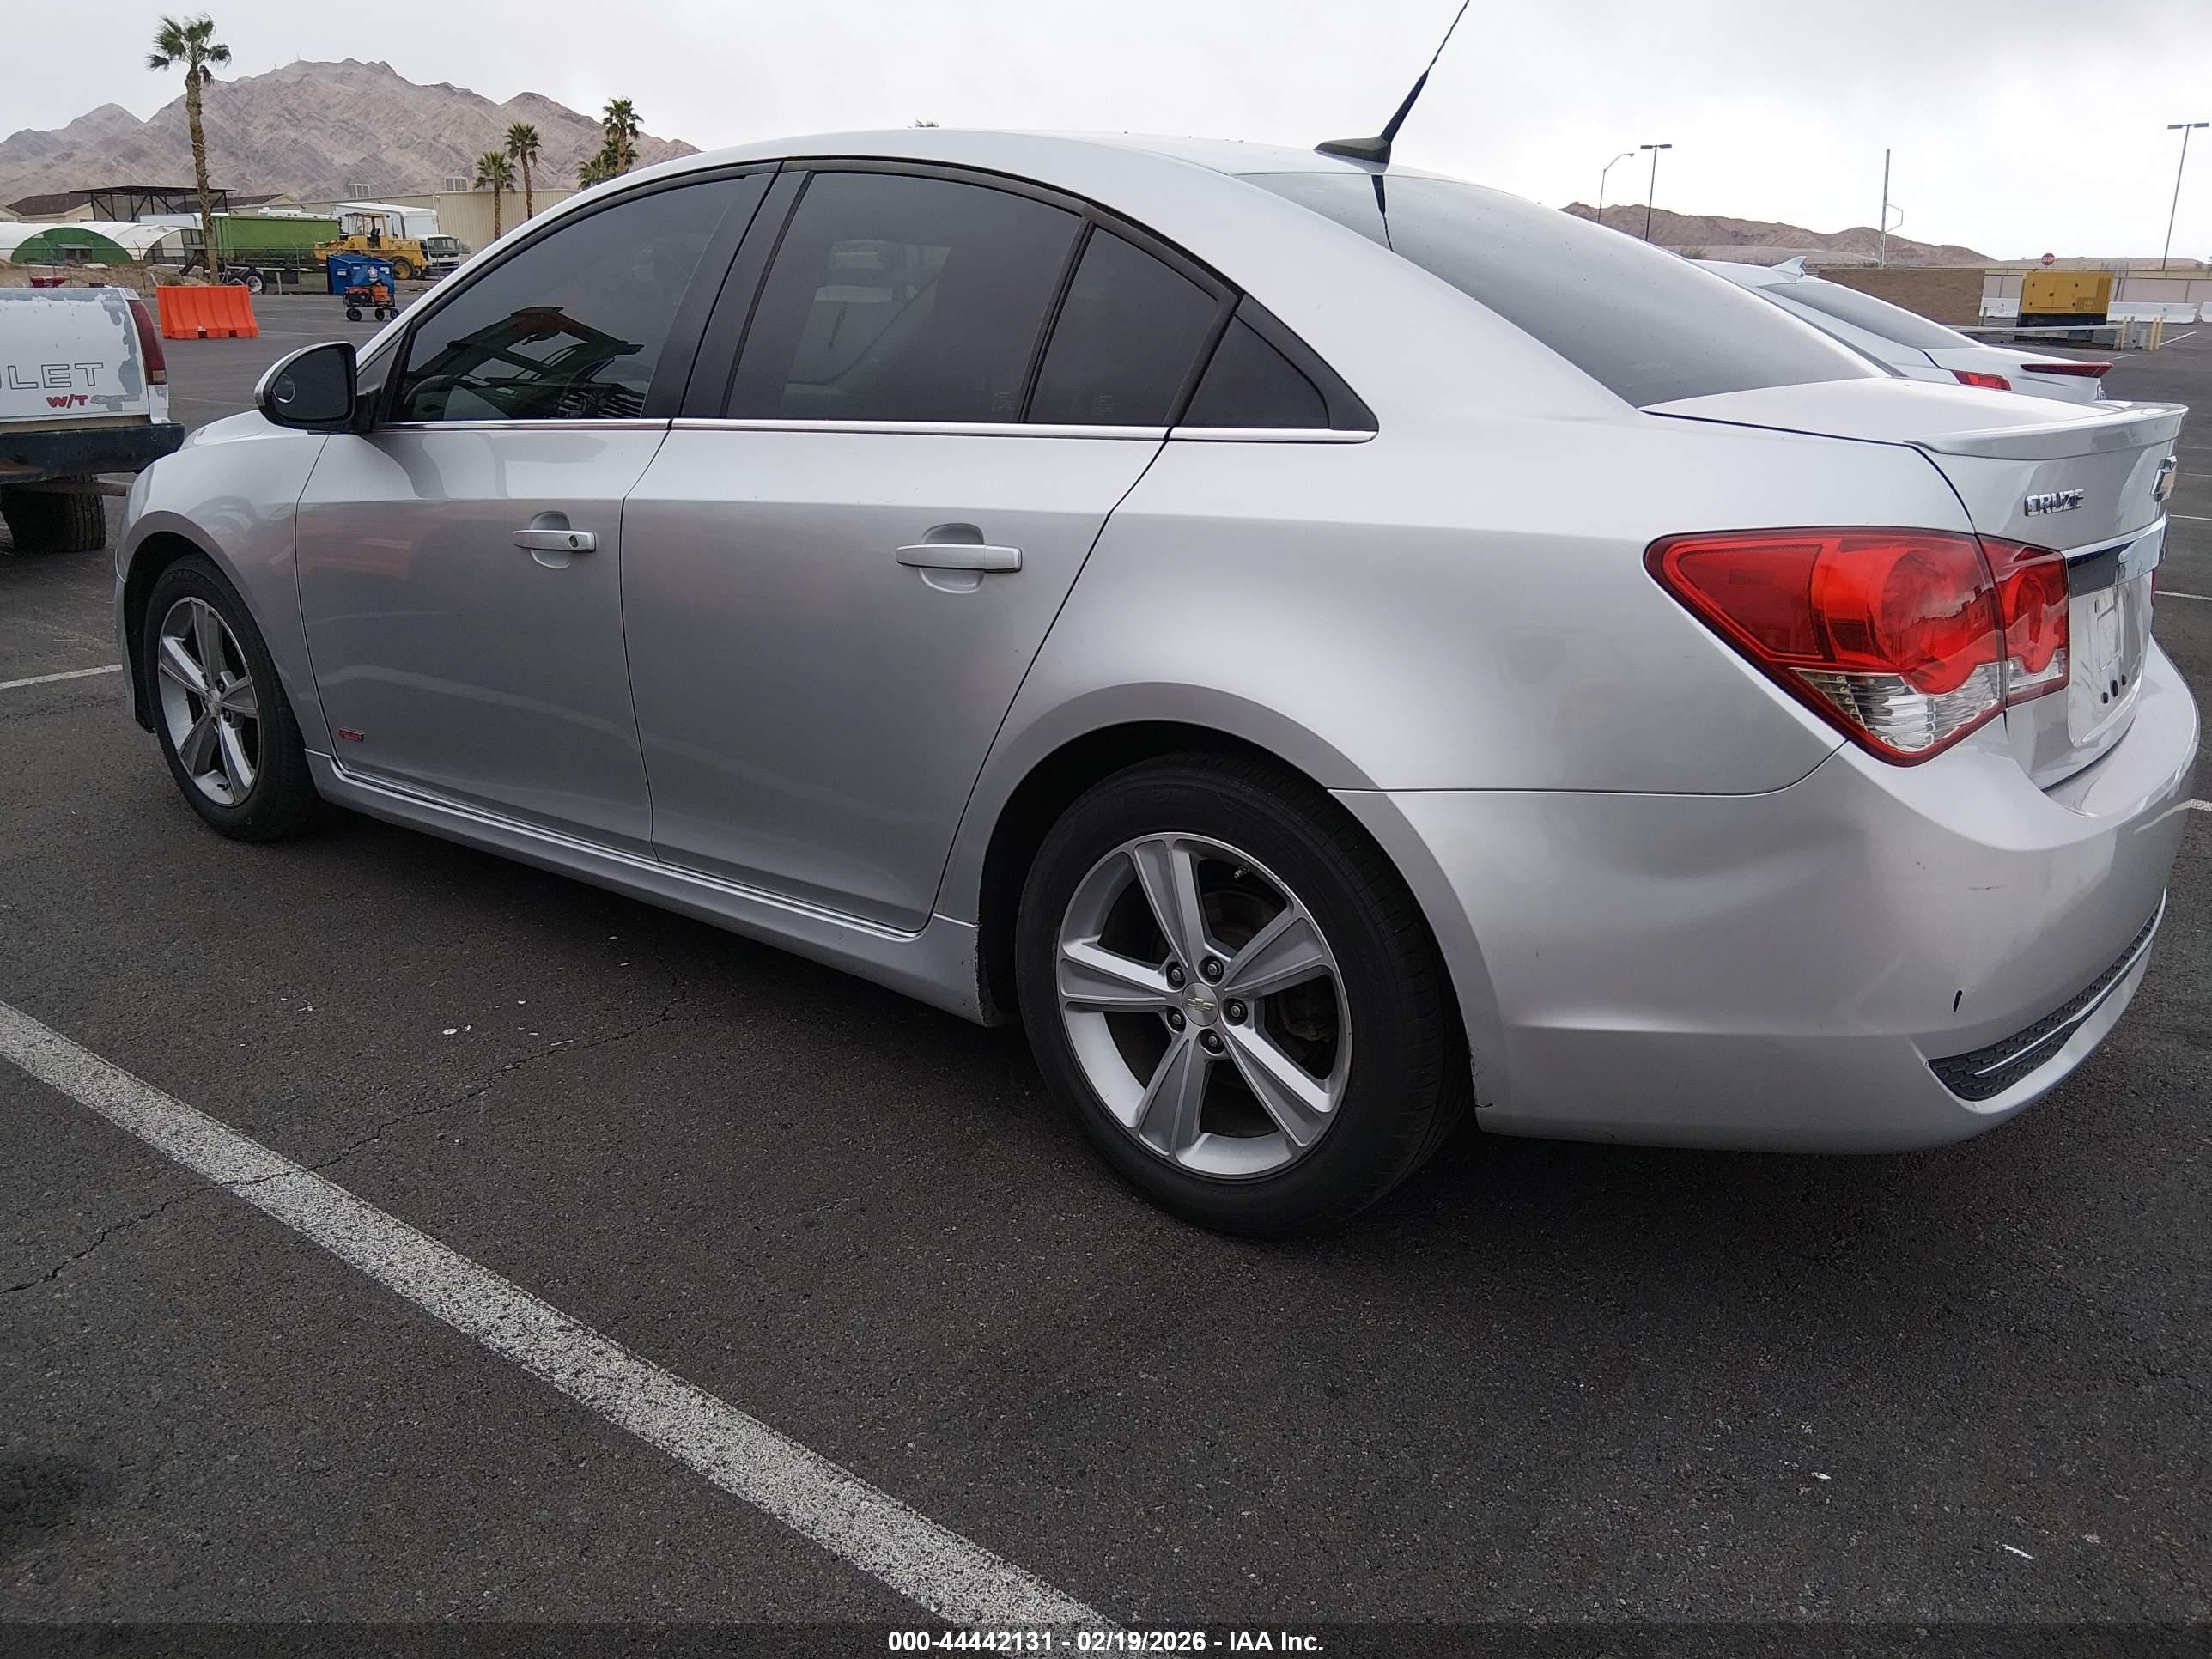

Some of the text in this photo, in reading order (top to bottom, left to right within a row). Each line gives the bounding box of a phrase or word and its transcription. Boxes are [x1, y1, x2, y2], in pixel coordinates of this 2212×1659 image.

[0, 362, 104, 390] LET
[46, 394, 88, 408] W/T
[2025, 489, 2085, 516] CRUZE
